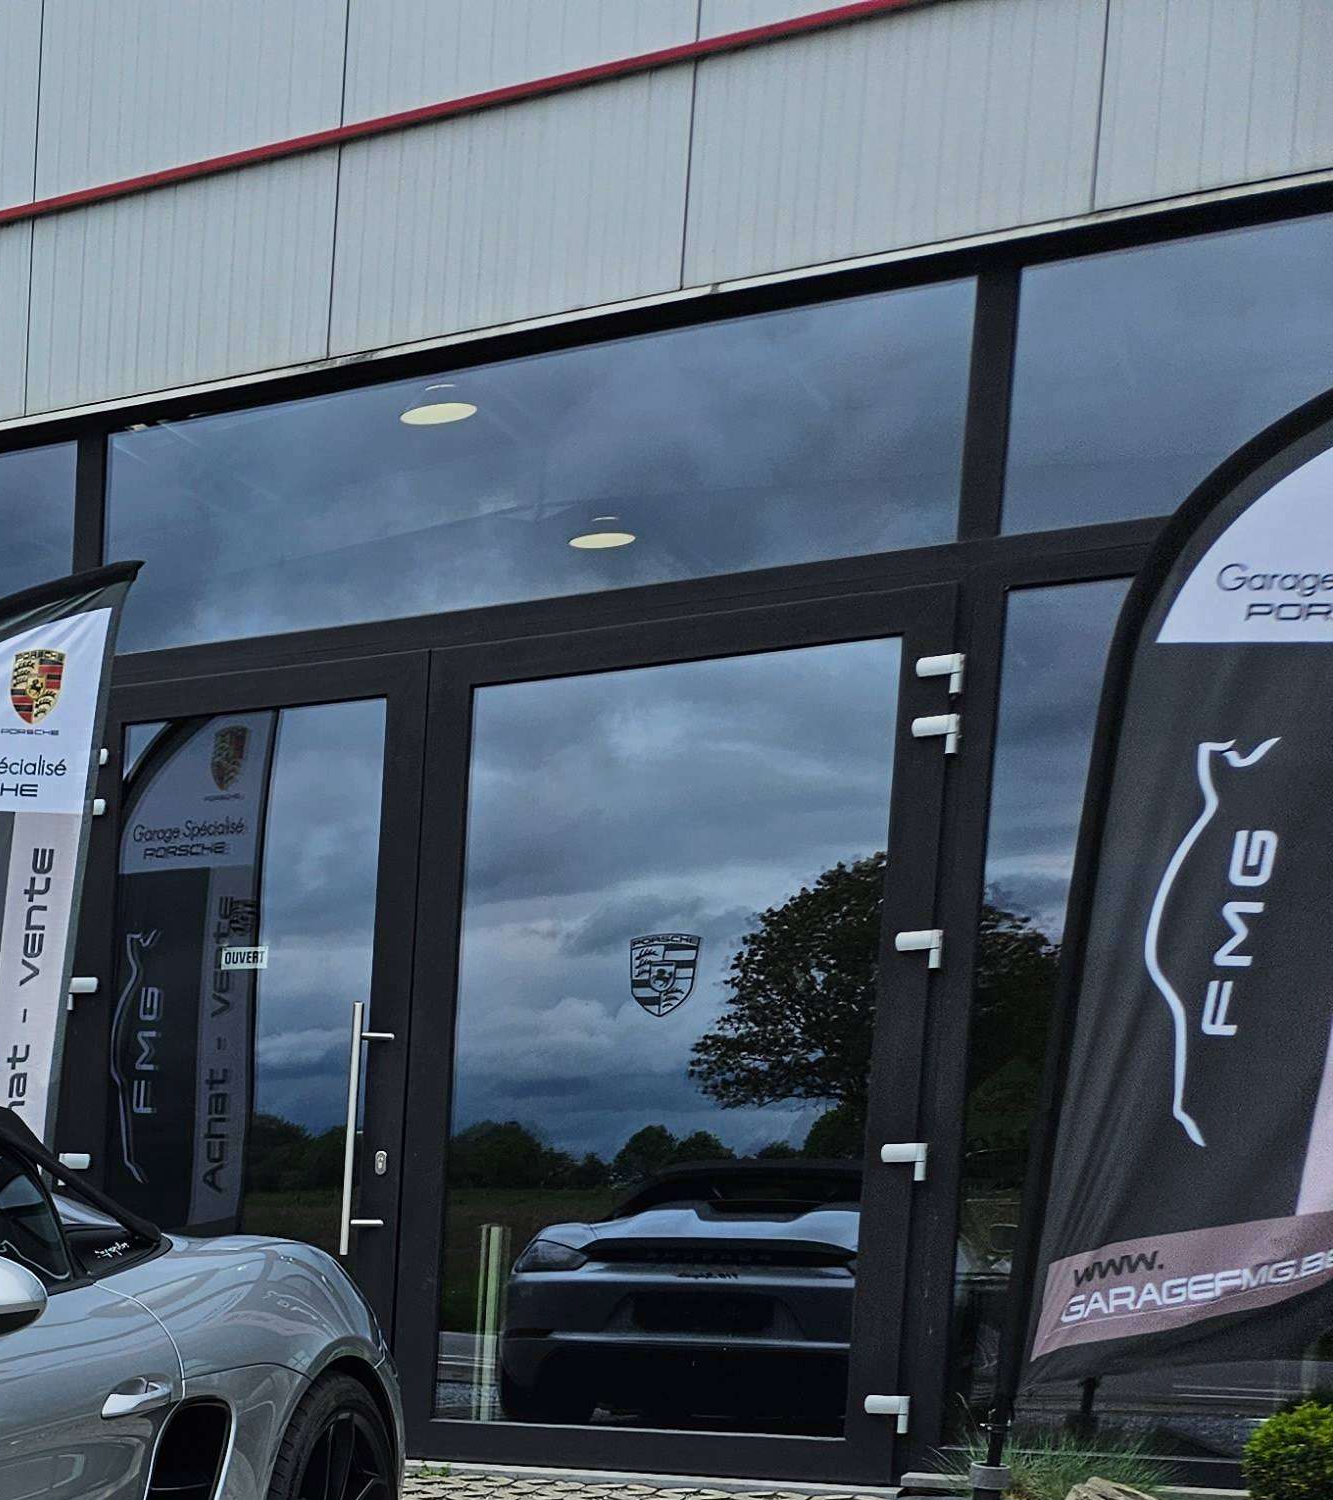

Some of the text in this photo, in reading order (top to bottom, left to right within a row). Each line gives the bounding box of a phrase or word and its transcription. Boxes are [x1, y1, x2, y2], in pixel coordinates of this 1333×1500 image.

[225, 951, 265, 965] OUVERT
[1201, 829, 1278, 1036] FMG
[133, 986, 161, 1114] FMG
